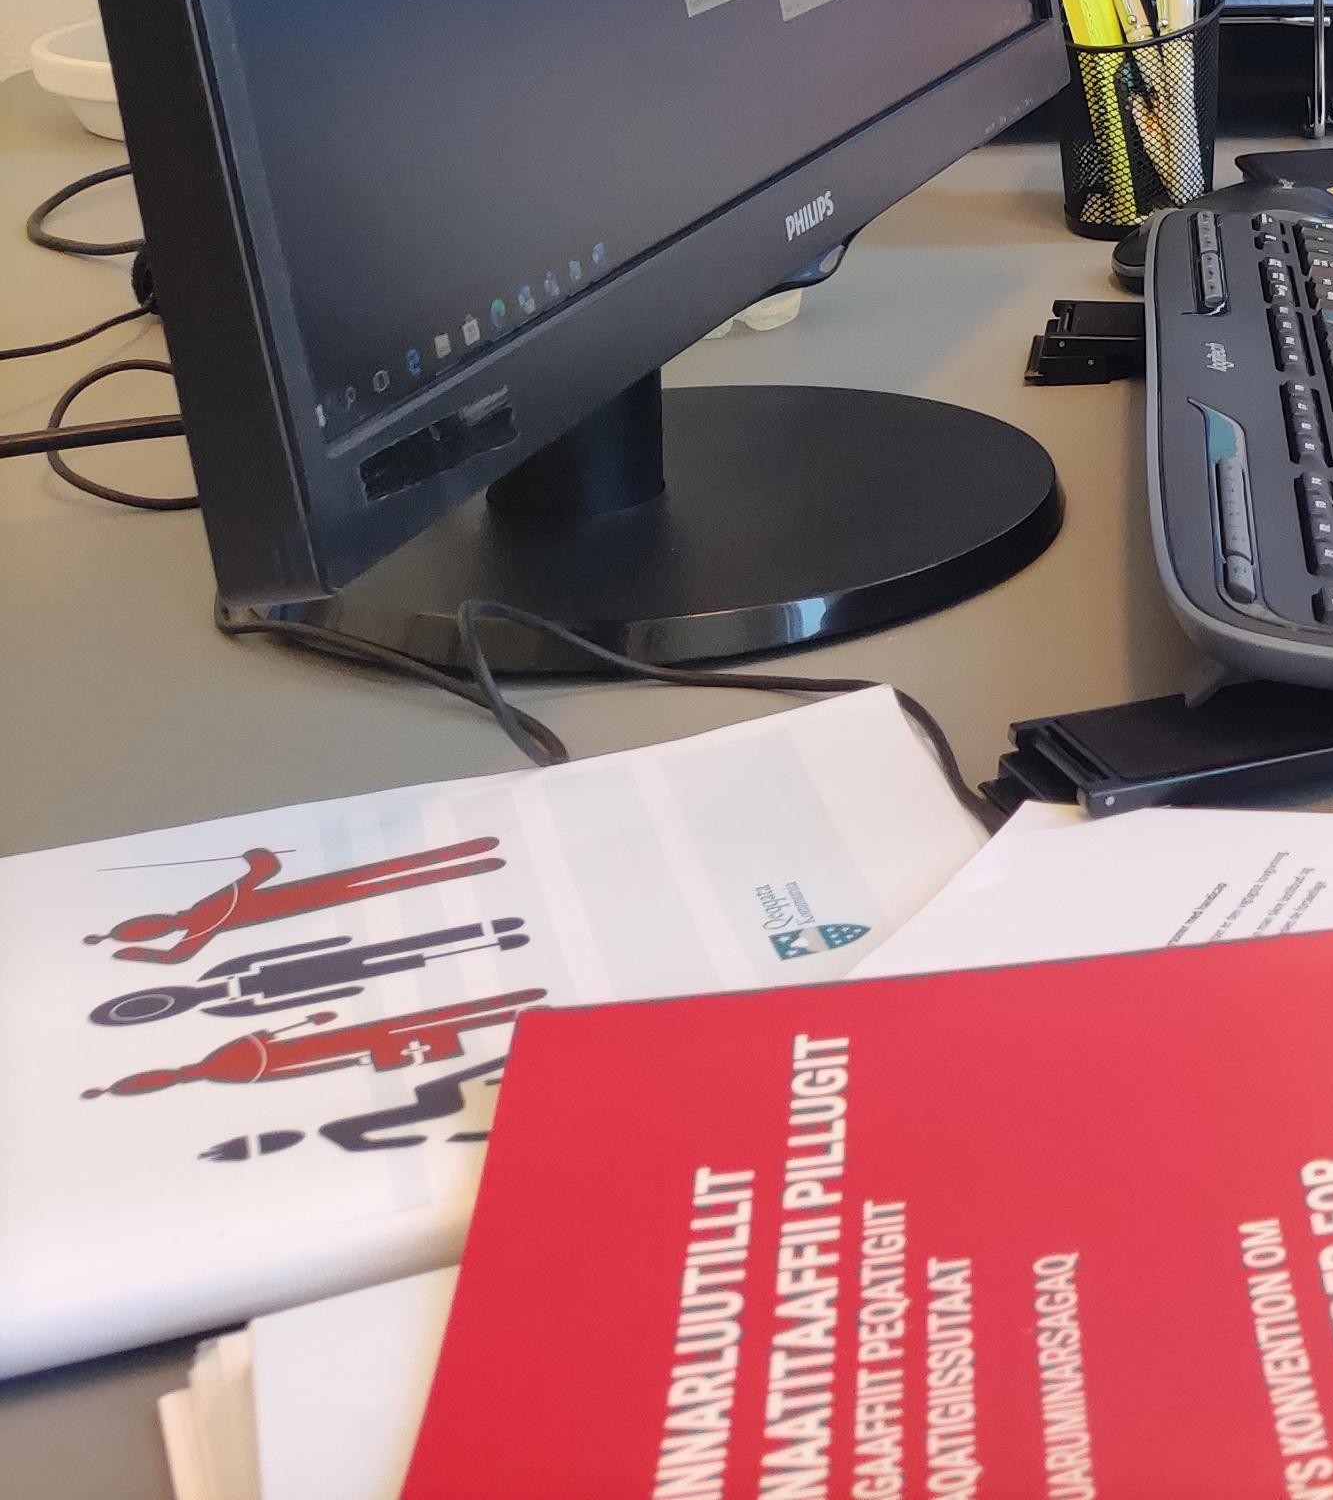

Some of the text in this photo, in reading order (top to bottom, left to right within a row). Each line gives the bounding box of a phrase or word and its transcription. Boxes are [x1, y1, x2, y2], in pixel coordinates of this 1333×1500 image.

[784, 190, 835, 242] PHILIPS
[782, 1034, 850, 1210] PILLUGIT
[1238, 1218, 1287, 1269] OM
[850, 1199, 912, 1500] GAAFFIIT PEQATIGIIT
[1247, 1271, 1328, 1456] KONVENTION
